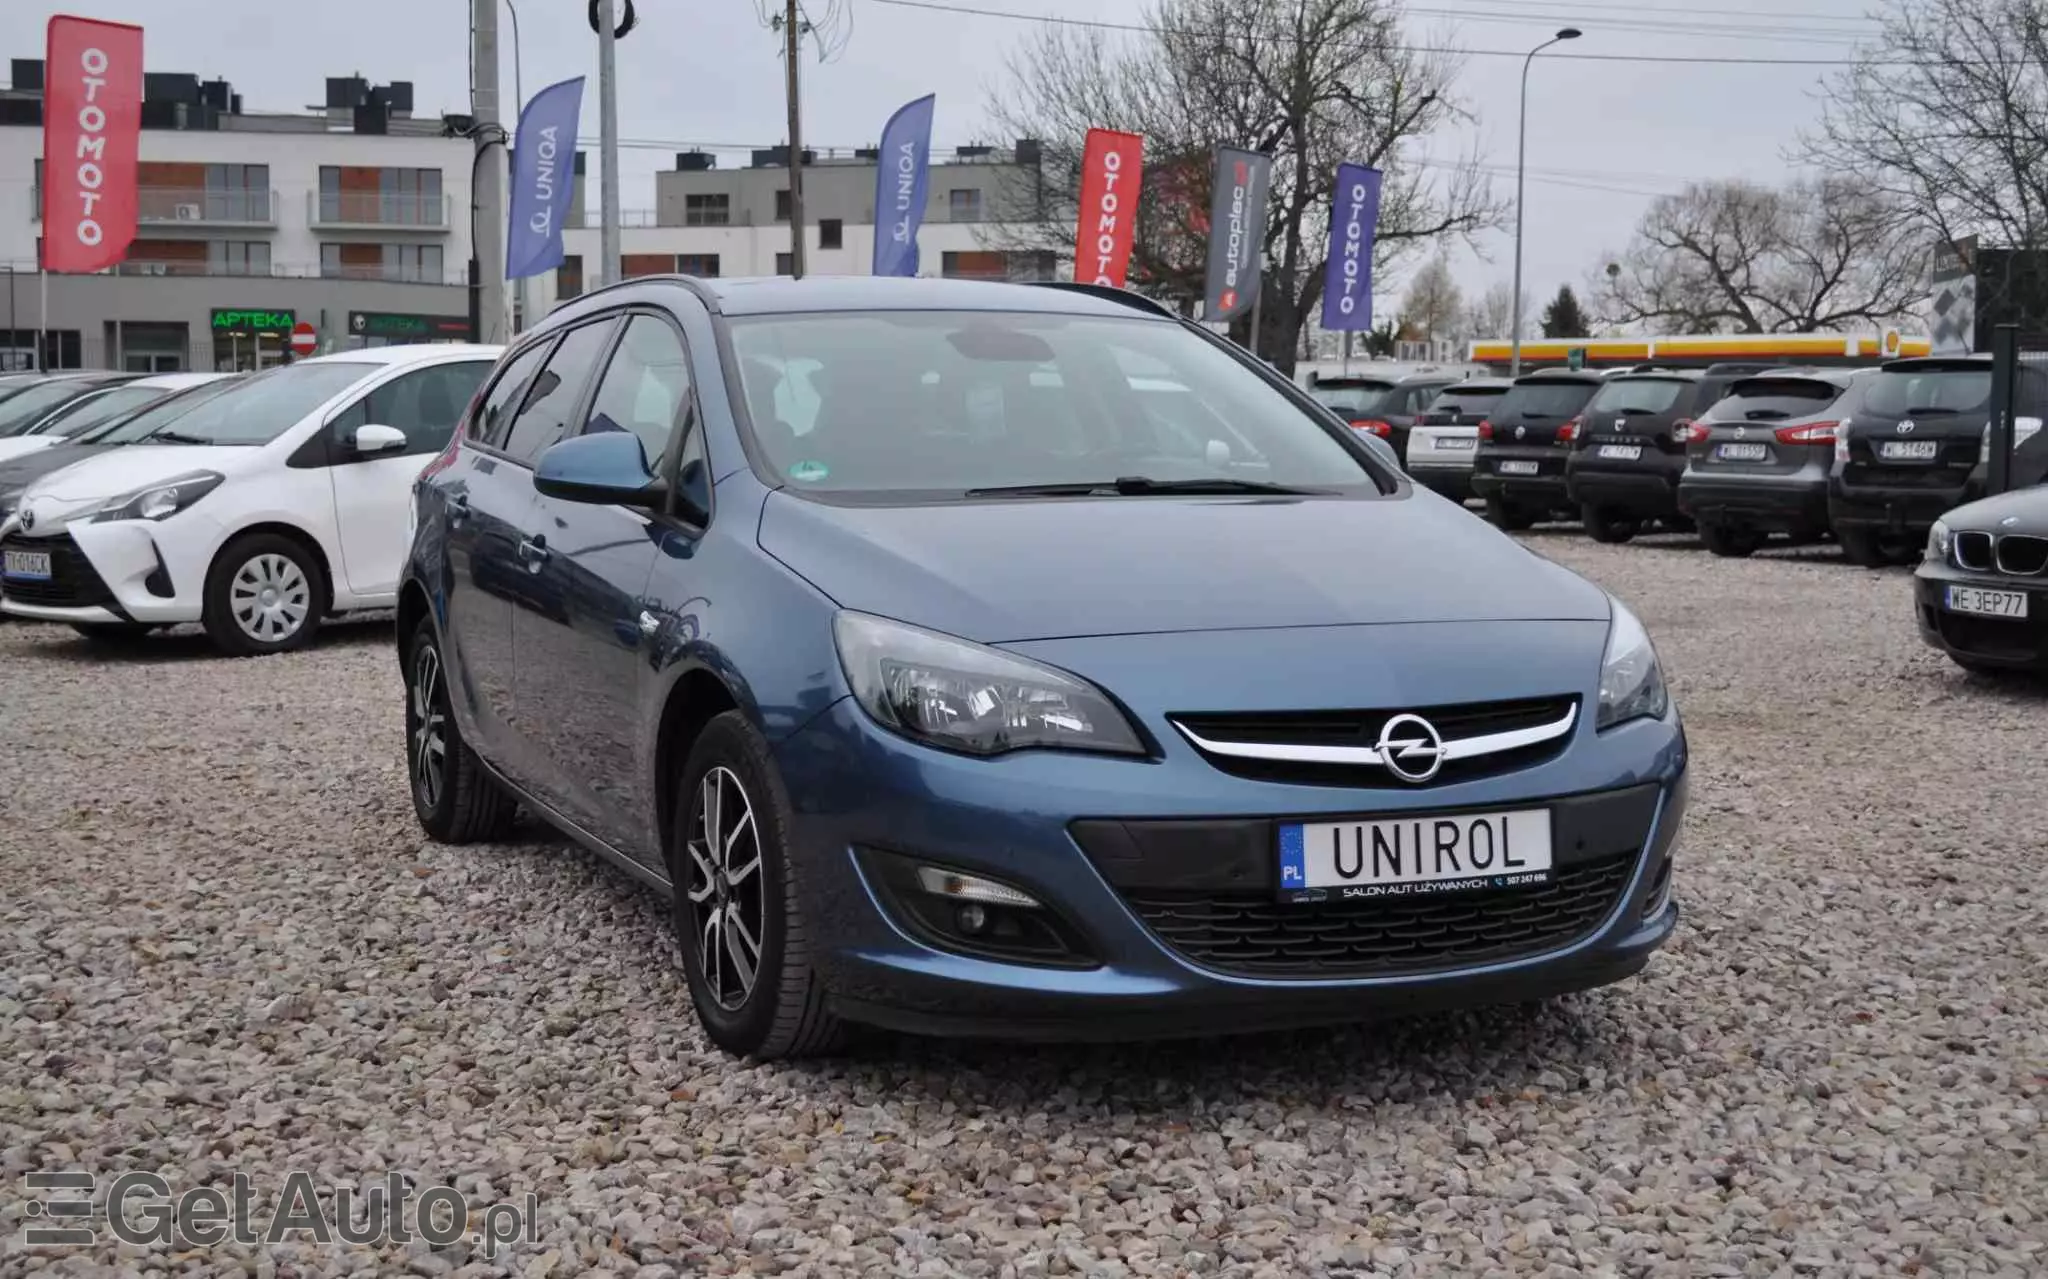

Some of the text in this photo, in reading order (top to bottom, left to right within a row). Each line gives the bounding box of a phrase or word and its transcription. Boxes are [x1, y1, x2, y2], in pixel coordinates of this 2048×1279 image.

[77, 48, 108, 245] OTOMOTO
[535, 126, 558, 200] UNIQA
[897, 142, 914, 210] UNIQA
[1340, 184, 1366, 314] OTOMOTO
[213, 311, 293, 328] APTEKA
[1952, 588, 2023, 614] WE 3EP77
[1283, 815, 1525, 881] PL UNIROL
[1343, 886, 1385, 898] SALON
[1387, 884, 1412, 895] AUT
